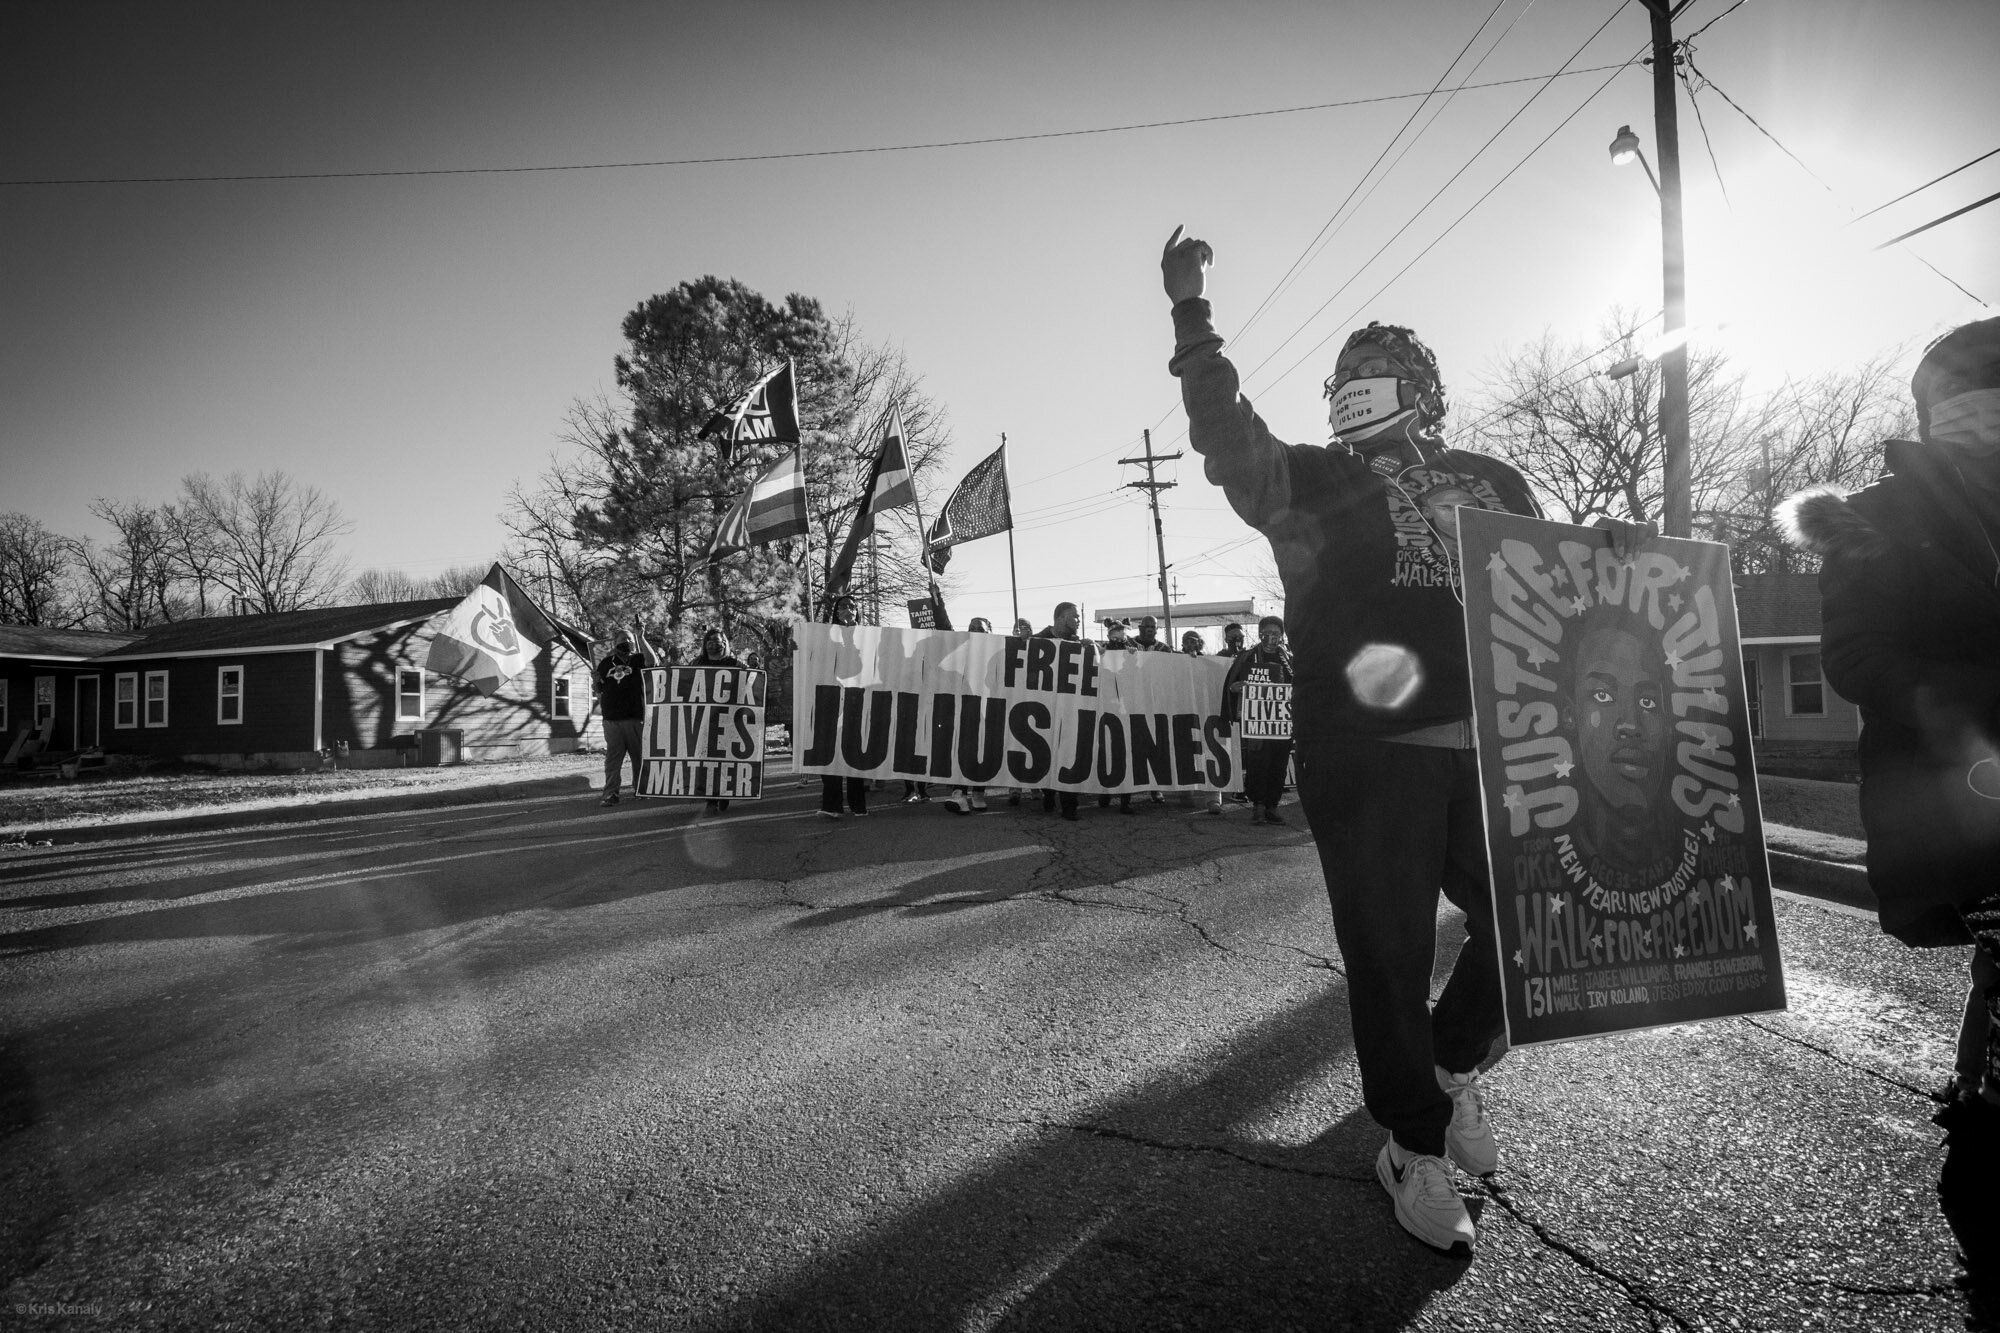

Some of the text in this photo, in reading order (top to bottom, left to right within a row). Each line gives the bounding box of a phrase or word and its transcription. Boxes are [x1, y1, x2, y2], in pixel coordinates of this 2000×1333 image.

[1335, 388, 1371, 407] JUSTICE
[1336, 404, 1349, 416] FOR
[1339, 407, 1372, 425] JULIUS
[1397, 550, 1421, 562] OKC
[1395, 562, 1442, 587] WALK
[920, 621, 936, 629] AND
[1004, 636, 1099, 697] FREE
[1248, 674, 1271, 682] REAL
[652, 669, 757, 705] BLACK
[1248, 686, 1293, 700] BLACK
[1490, 539, 1745, 837] JUSTICE FOR JULIUS
[1248, 701, 1292, 720] LIVES
[649, 706, 756, 760] LIVES
[804, 684, 1052, 785] JULIUS
[1056, 708, 1231, 790] JONES
[646, 761, 753, 797] MATTER
[1553, 827, 1702, 915] NEW YEAR! NEW JUSTICE!
[1515, 875, 1760, 974] WALK FOR FREEDOM
[1553, 974, 1580, 994] MILE
[1586, 989, 1610, 1009] IRV
[1610, 986, 1651, 1006] ROLAND,
[1651, 984, 1681, 1002] JESS
[1524, 976, 1554, 1019] 131
[1553, 993, 1584, 1012] WALK
